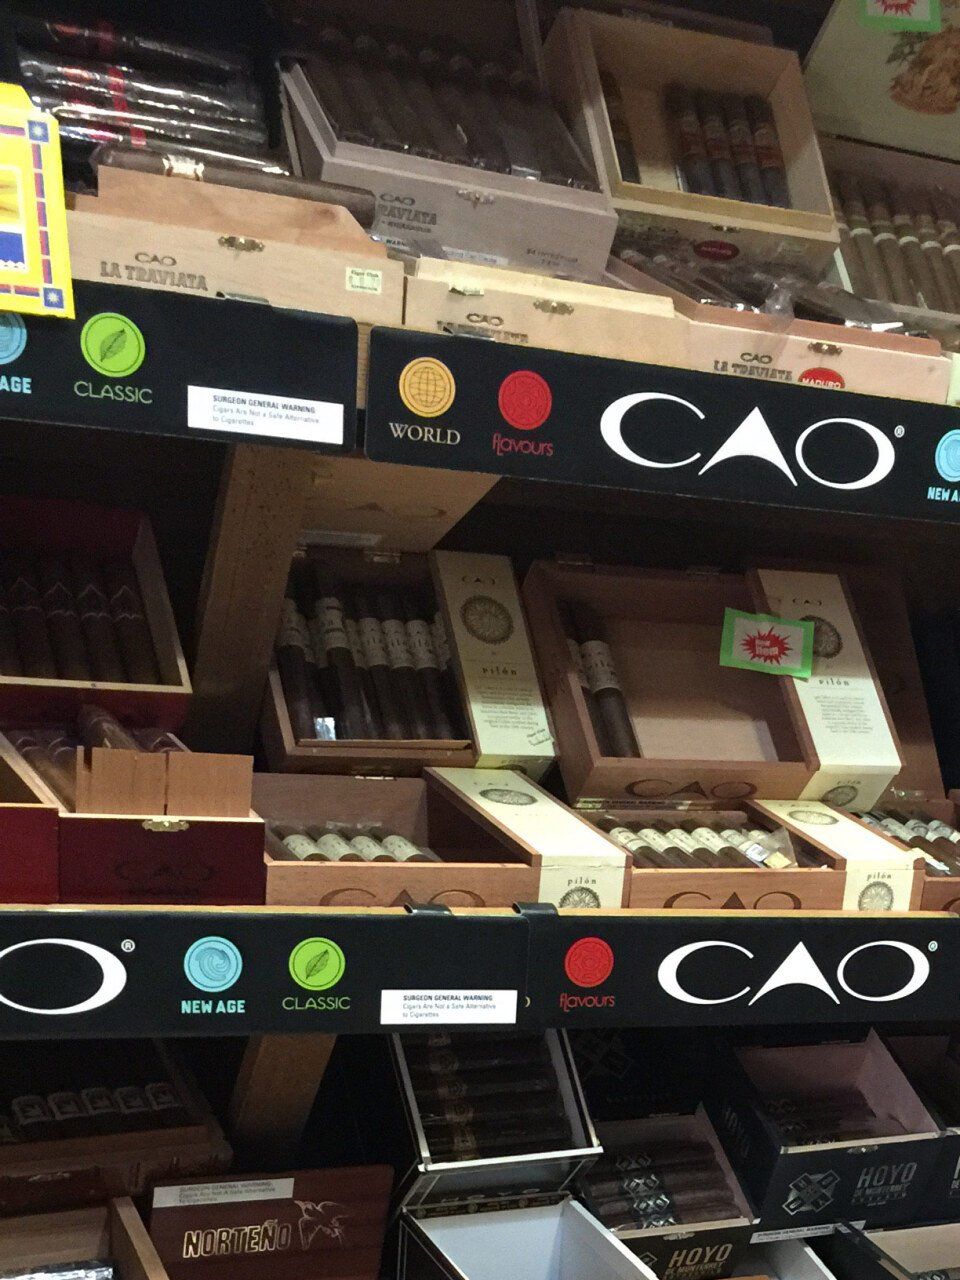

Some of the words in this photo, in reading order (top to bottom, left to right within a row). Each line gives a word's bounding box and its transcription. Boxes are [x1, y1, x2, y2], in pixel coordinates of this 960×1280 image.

[134, 252, 178, 267] CAO
[100, 261, 122, 279] LA
[125, 265, 209, 292] TRAVIATA
[466, 312, 505, 327] CAO
[740, 352, 773, 365] CAO
[73, 381, 154, 404] CLASSIC
[212, 395, 247, 406] SURGEON
[248, 399, 279, 410] GENERAL
[281, 403, 316, 414] WARNING
[389, 422, 461, 446] WORLD
[600, 392, 896, 490] CAO
[492, 433, 554, 457] flavours
[926, 486, 950, 501] NEW
[567, 876, 598, 887] pilón
[867, 870, 892, 882] pilón
[657, 940, 931, 1006] CAO
[180, 999, 214, 1015] NEW
[217, 998, 246, 1014] AGE
[282, 995, 351, 1011] CLASSIC
[434, 994, 462, 1002] GENERAL
[559, 993, 615, 1012] flavours
[857, 1162, 918, 1188] HOYO
[182, 1219, 293, 1259] NORTEÑO
[668, 1243, 734, 1268] HOYO
